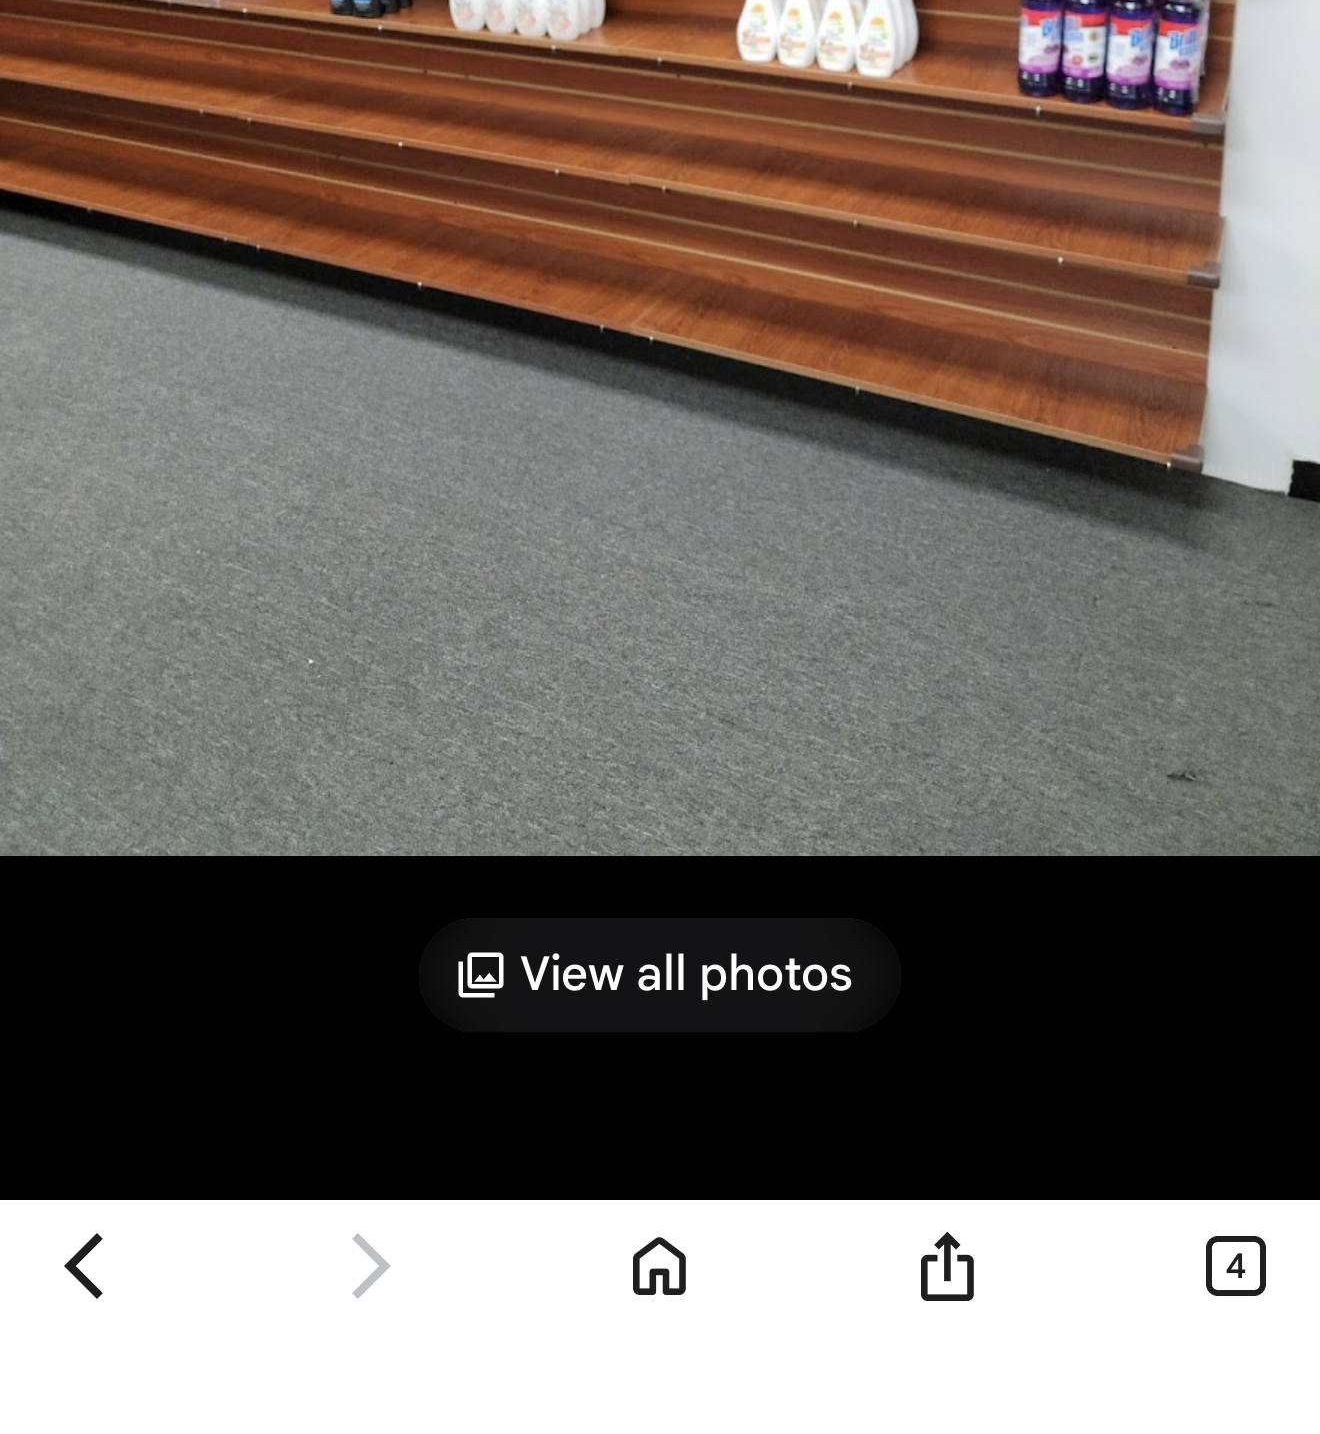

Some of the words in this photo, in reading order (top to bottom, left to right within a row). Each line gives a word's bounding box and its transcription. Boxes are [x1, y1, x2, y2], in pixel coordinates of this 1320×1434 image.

[520, 952, 625, 992] View
[637, 952, 685, 992] all
[701, 952, 852, 1001] photos
[1225, 1252, 1246, 1279] 4
